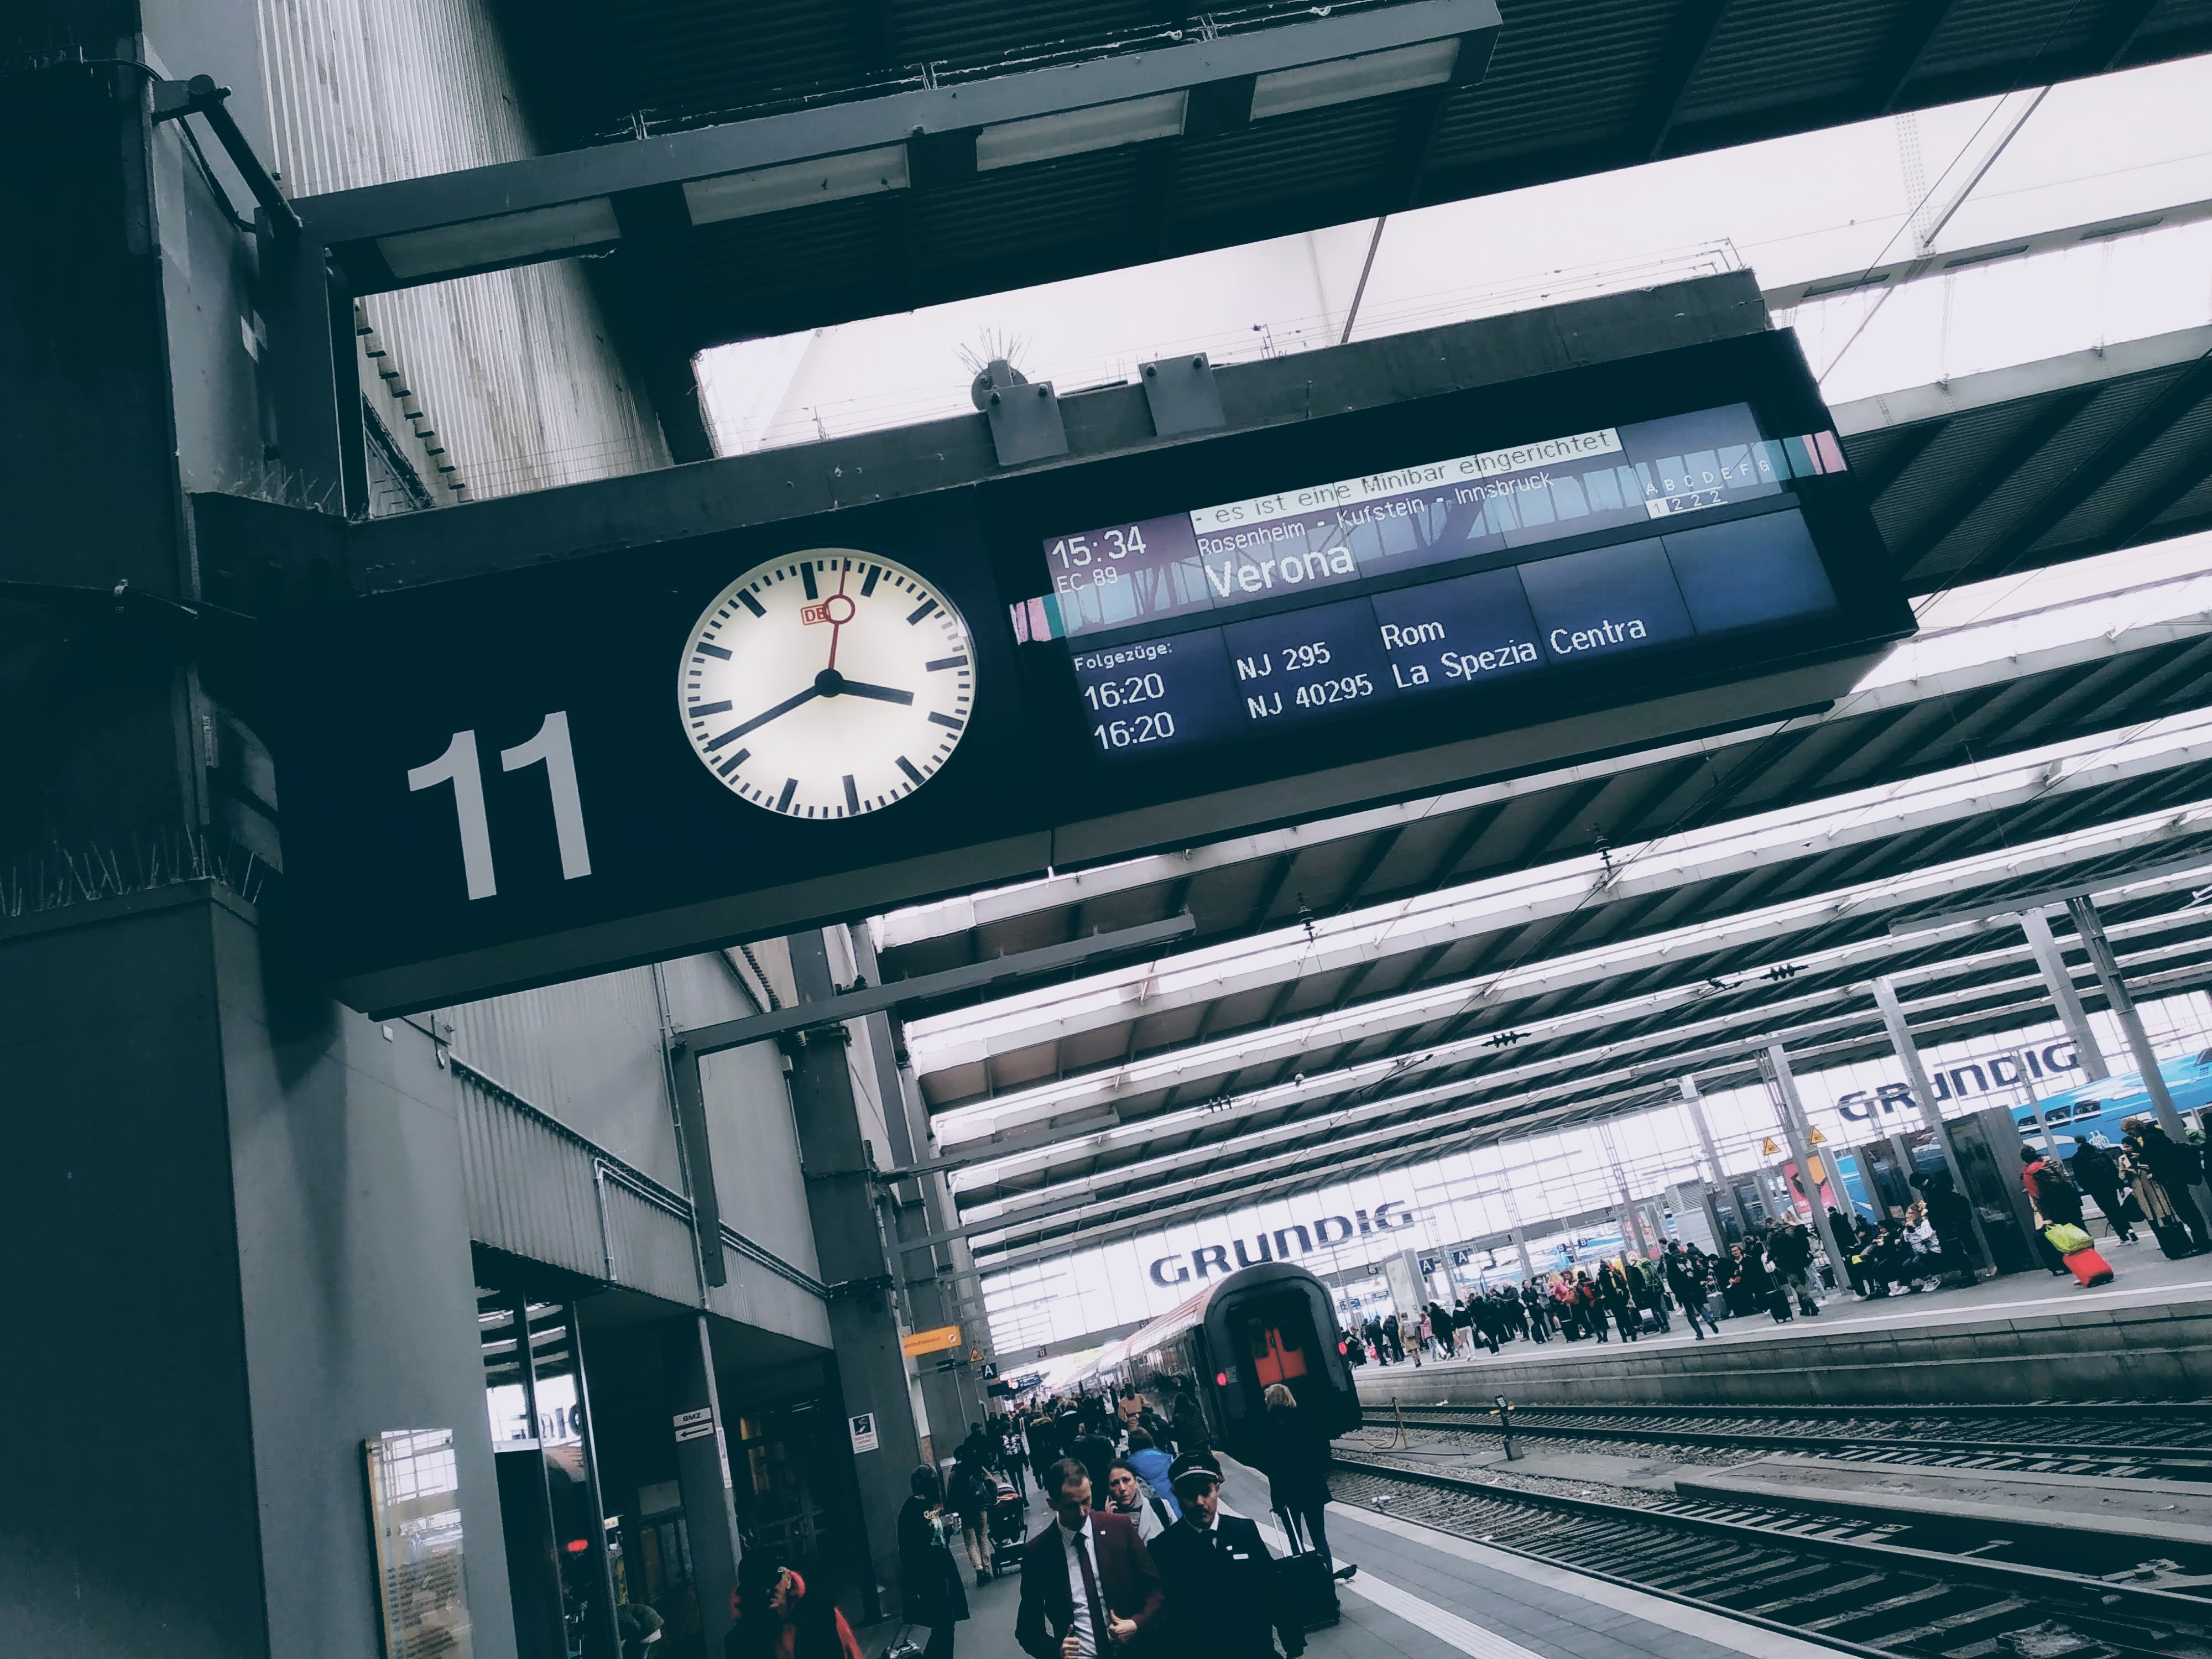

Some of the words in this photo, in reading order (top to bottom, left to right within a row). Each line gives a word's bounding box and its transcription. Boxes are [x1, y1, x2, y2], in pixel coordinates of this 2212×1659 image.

[1215, 505, 1244, 523] es
[1254, 494, 1287, 516] ist
[1298, 483, 1352, 507] eine
[1361, 465, 1446, 494] Minibar
[1459, 431, 1611, 474] eingerichtet
[1646, 482, 1658, 495] A
[1664, 479, 1676, 492] B
[1683, 475, 1695, 487] C
[1702, 471, 1715, 484] D
[1721, 467, 1733, 480] E
[1739, 463, 1749, 476] F
[1758, 460, 1770, 472] G
[1197, 521, 1306, 556] Rosenheim
[1336, 497, 1426, 529] Kufstein
[1454, 471, 1555, 505] Innsbruck
[1653, 502, 1661, 514] 1
[1671, 498, 1683, 511] 2
[1691, 494, 1703, 507] 2
[1709, 491, 1721, 503] 2
[1051, 526, 1147, 569] 15:34
[1057, 572, 1084, 594] EC
[1092, 566, 1119, 587] 89
[1206, 544, 1355, 598] Verona
[1074, 641, 1173, 672] Folgezüge:
[1084, 672, 1165, 711] 16:20
[1236, 653, 1272, 681] NJ
[1282, 641, 1332, 673] 295
[1380, 619, 1446, 651] Rom
[1094, 711, 1175, 750] 16:20
[1247, 692, 1283, 719] NJ
[1295, 673, 1374, 709] 40295
[1391, 663, 1430, 690] La
[1439, 638, 1538, 682] Spezia
[1549, 617, 1648, 656] Centra
[408, 711, 592, 901] 11
[1149, 1200, 1414, 1287] GRUNDIG
[1458, 1251, 1467, 1263] A
[1422, 1260, 1432, 1272] A
[984, 1364, 993, 1377] A
[682, 1412, 702, 1422] BMZ
